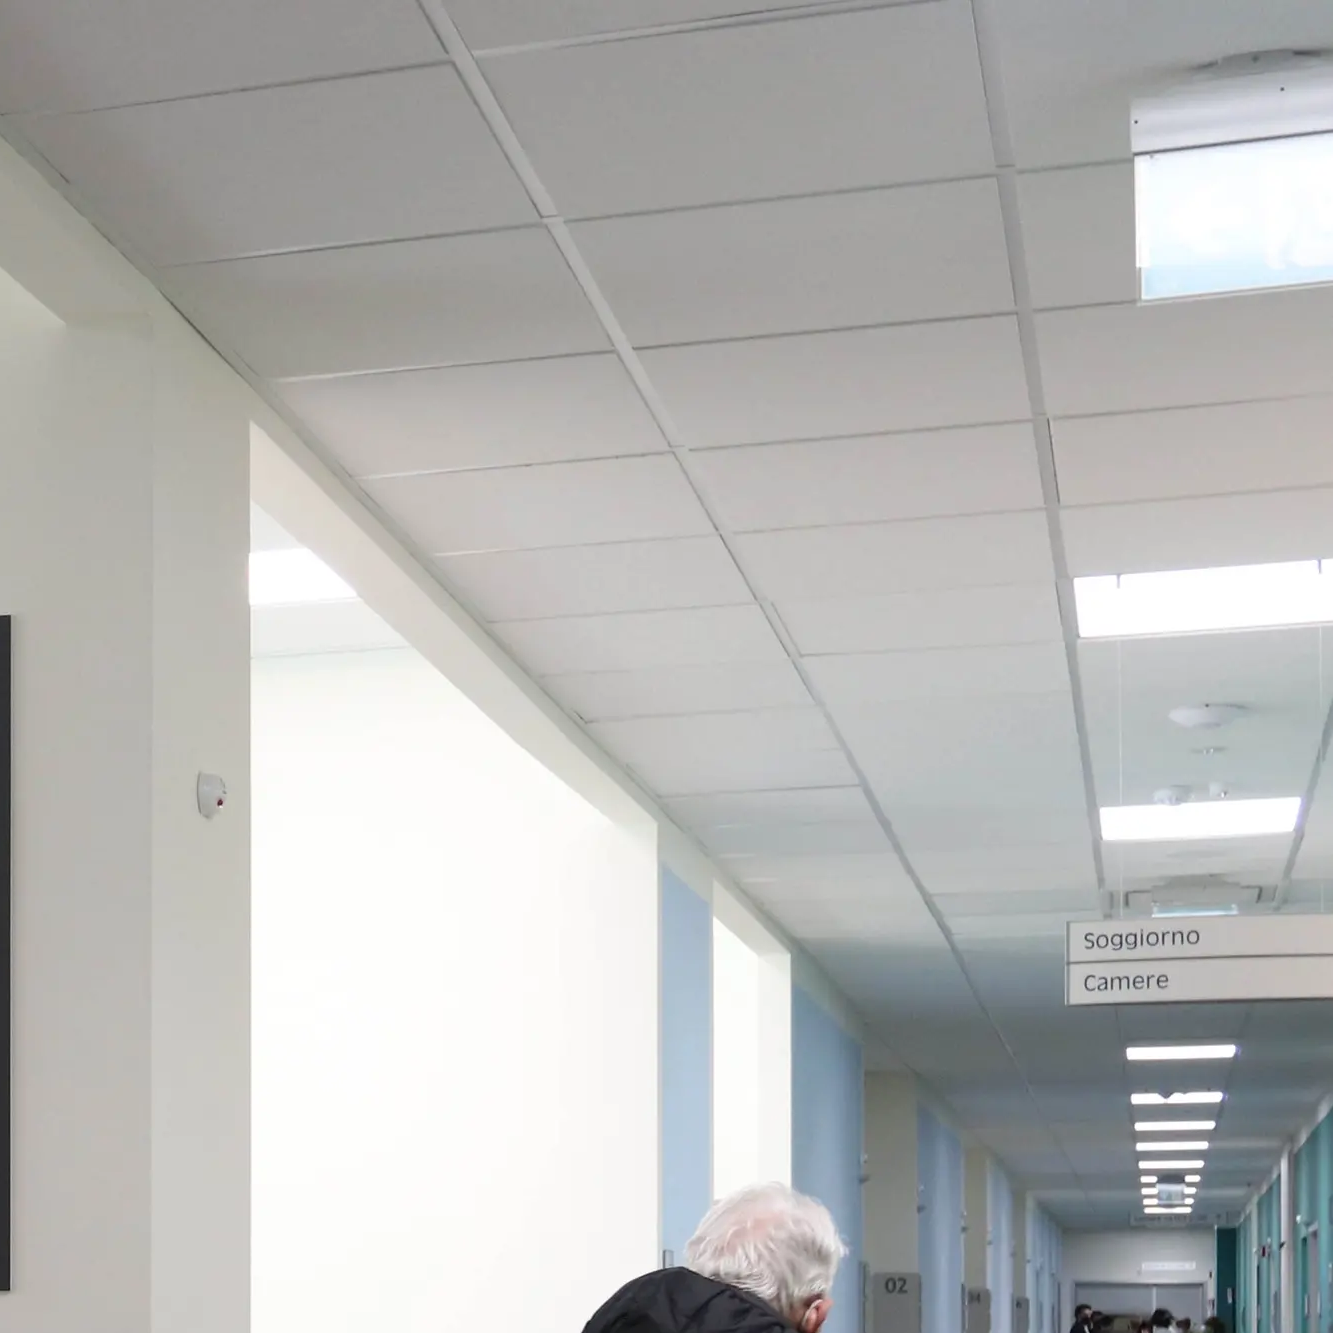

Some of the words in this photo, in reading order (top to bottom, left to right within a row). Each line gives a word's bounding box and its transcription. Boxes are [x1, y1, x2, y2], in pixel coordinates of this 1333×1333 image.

[1084, 929, 1201, 951] Soggiorno
[1084, 973, 1170, 992] Camere
[885, 1277, 908, 1294] 02
